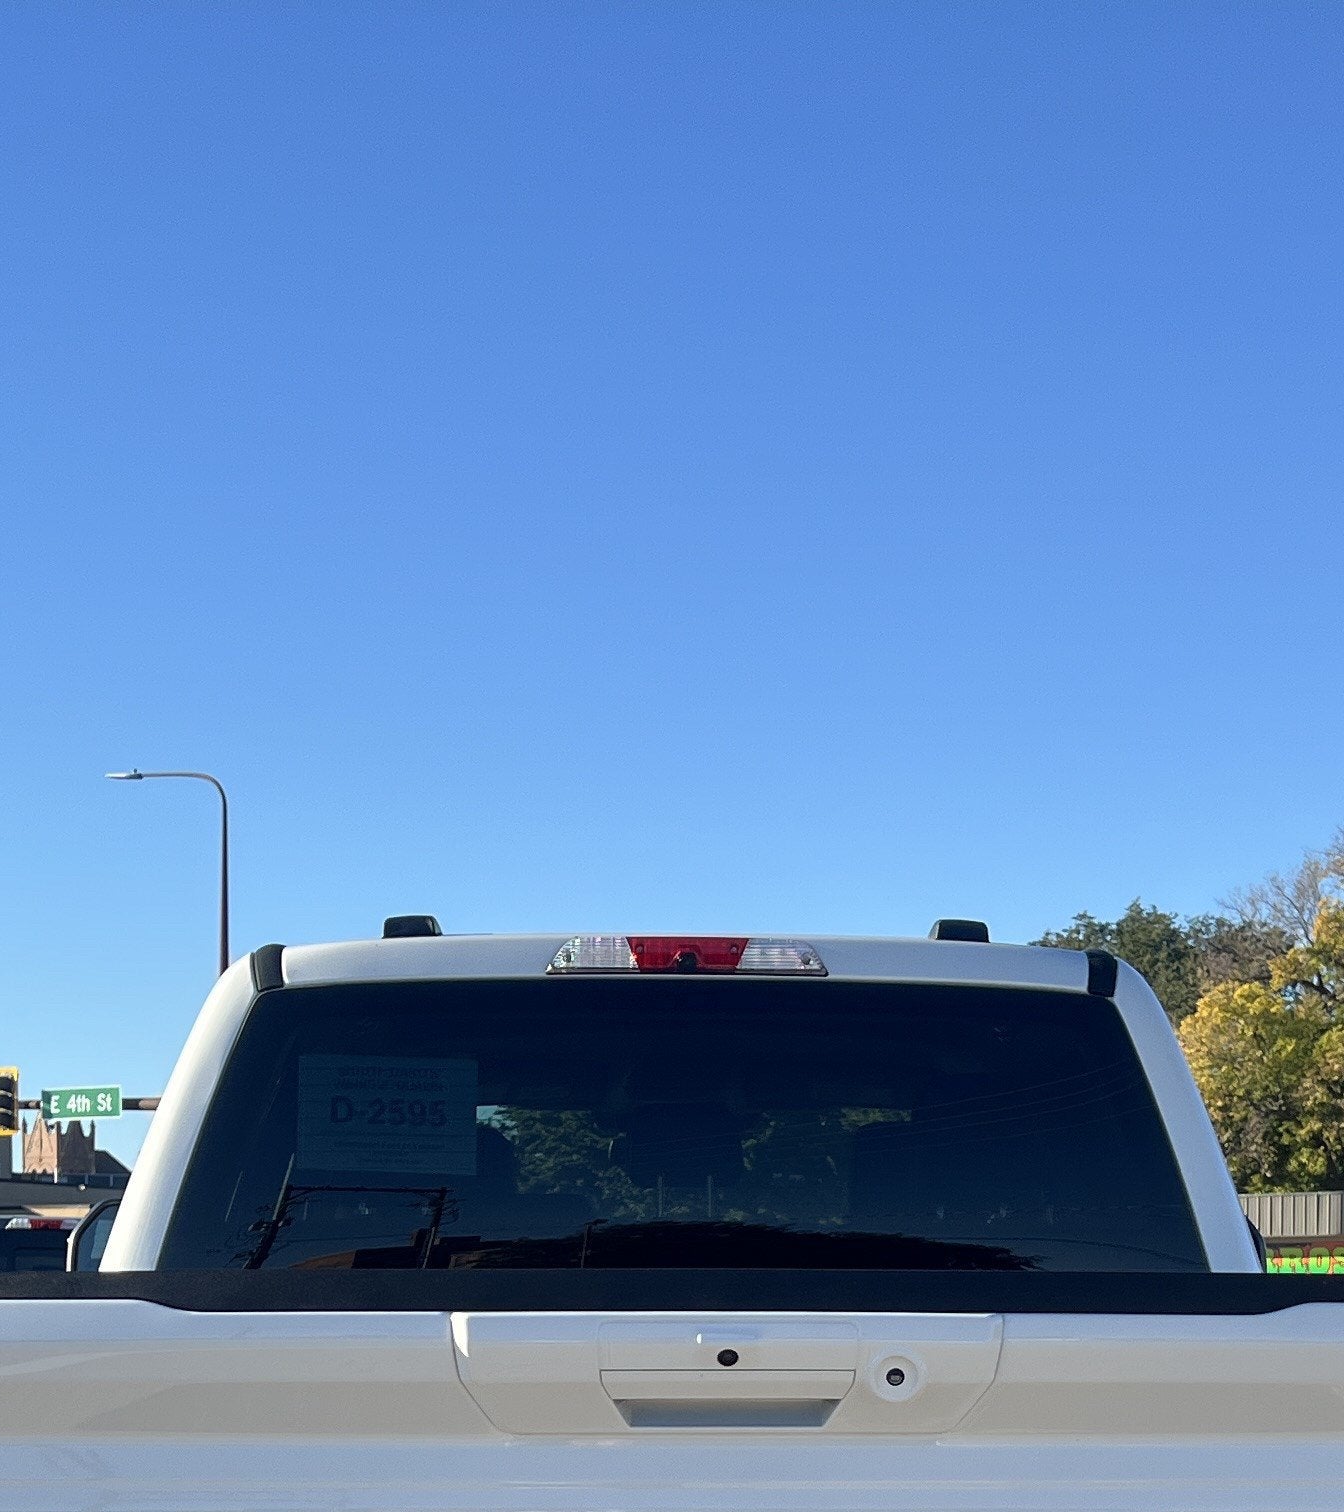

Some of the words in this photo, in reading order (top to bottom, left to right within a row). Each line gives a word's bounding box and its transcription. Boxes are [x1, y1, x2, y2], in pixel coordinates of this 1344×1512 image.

[50, 1095, 61, 1114] E
[66, 1094, 91, 1113] 4th
[97, 1092, 113, 1112] St
[330, 1095, 447, 1127] D-2595
